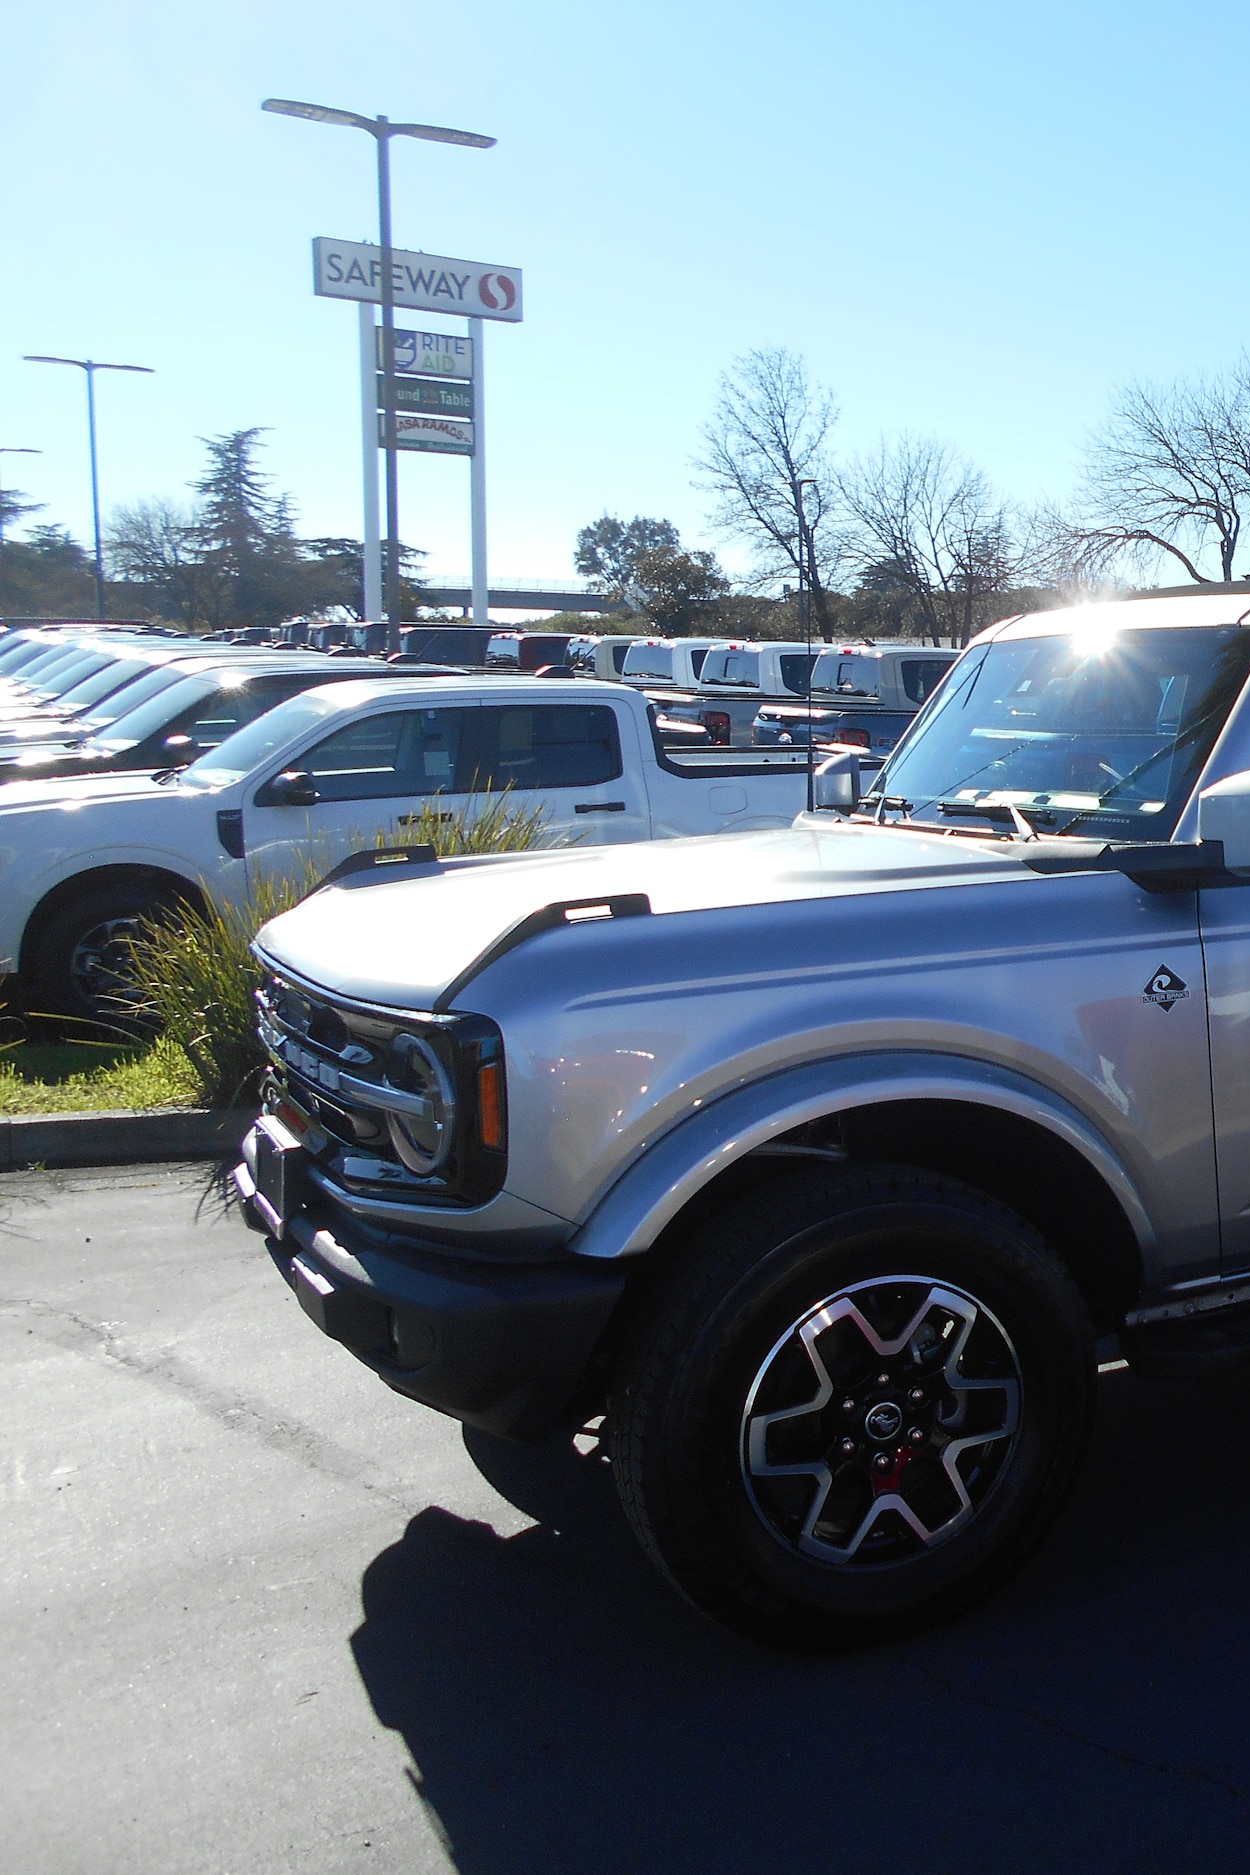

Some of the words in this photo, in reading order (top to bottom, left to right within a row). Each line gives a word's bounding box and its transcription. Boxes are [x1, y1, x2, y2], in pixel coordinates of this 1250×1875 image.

[327, 253, 471, 300] SAFEWAY
[422, 333, 466, 355] RITE
[422, 355, 456, 373] AID
[397, 388, 420, 402] und
[439, 390, 471, 407] Table
[395, 419, 420, 433] ASA
[1166, 991, 1189, 1000] BANKS
